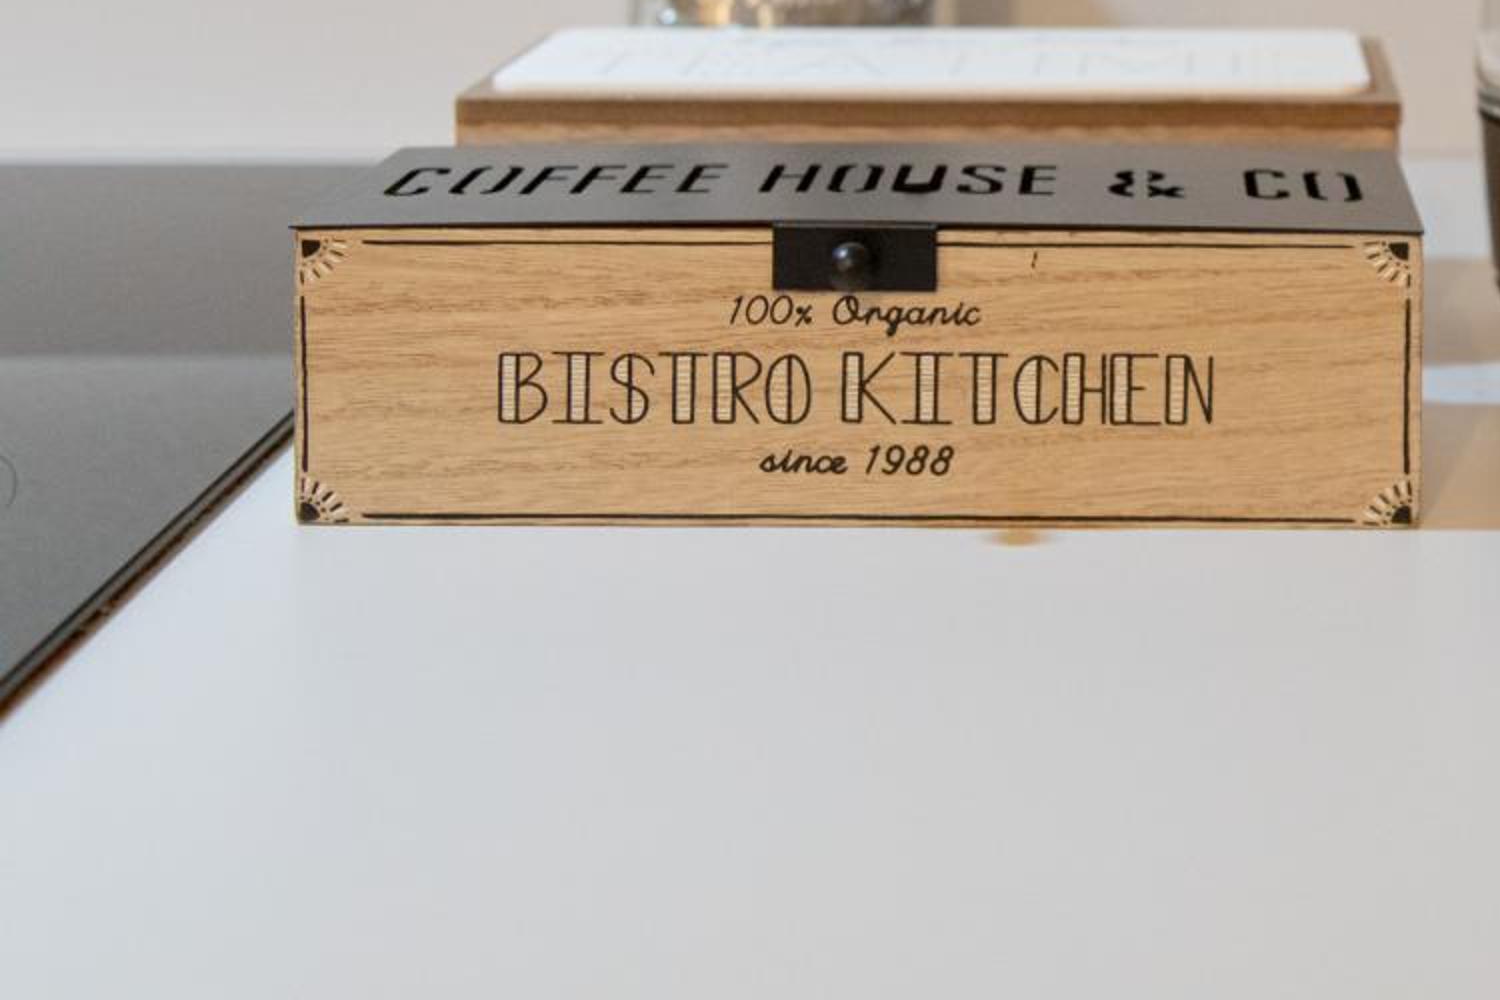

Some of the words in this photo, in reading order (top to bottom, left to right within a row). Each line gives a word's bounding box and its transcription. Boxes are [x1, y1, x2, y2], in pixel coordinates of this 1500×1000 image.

[382, 164, 723, 196] COFFEE
[758, 163, 1058, 197] HOUSE
[1107, 169, 1186, 198] &
[1242, 169, 1365, 201] CO
[729, 295, 813, 327] 100%
[832, 295, 982, 337] Organic
[497, 351, 812, 425] BISTRO
[840, 350, 1215, 426] KITCHEN
[759, 449, 849, 475] since
[864, 444, 956, 476] 1988
